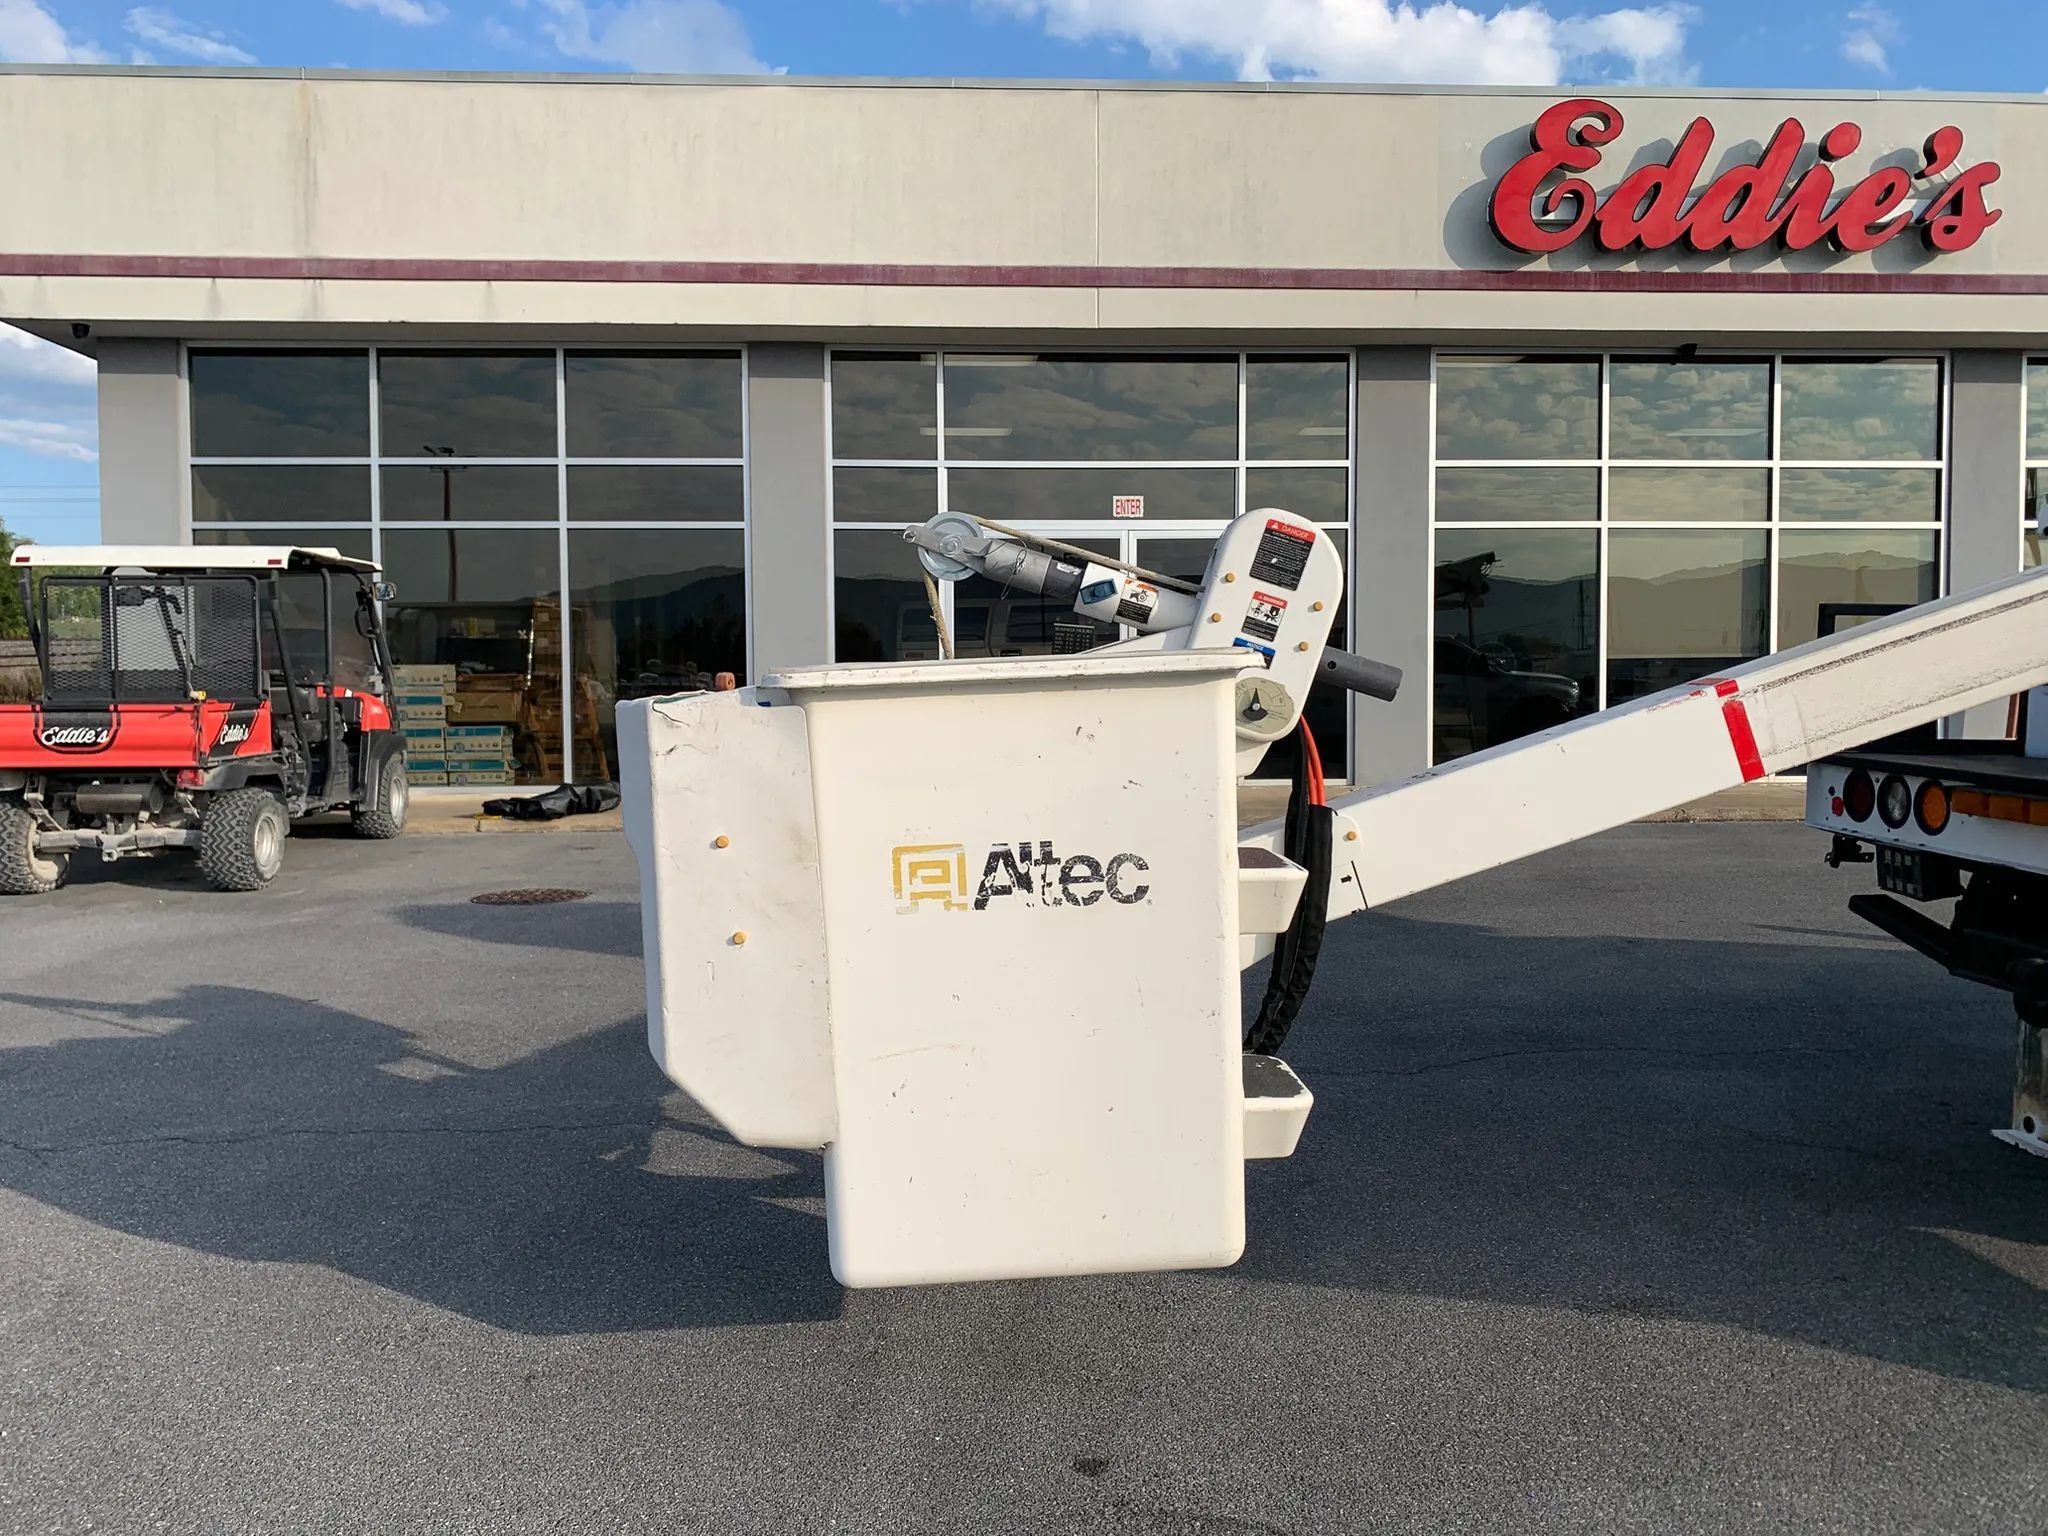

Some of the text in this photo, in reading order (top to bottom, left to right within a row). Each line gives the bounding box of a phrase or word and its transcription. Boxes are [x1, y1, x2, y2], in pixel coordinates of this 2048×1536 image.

[1489, 98, 2002, 253] Eddie's
[1115, 499, 1141, 515] ENTER
[1281, 525, 1309, 538] DANGER
[1263, 595, 1285, 606] DANGER
[41, 726, 111, 746] Eddie's
[220, 724, 250, 745] Eddie's
[972, 840, 1150, 910] Altec
